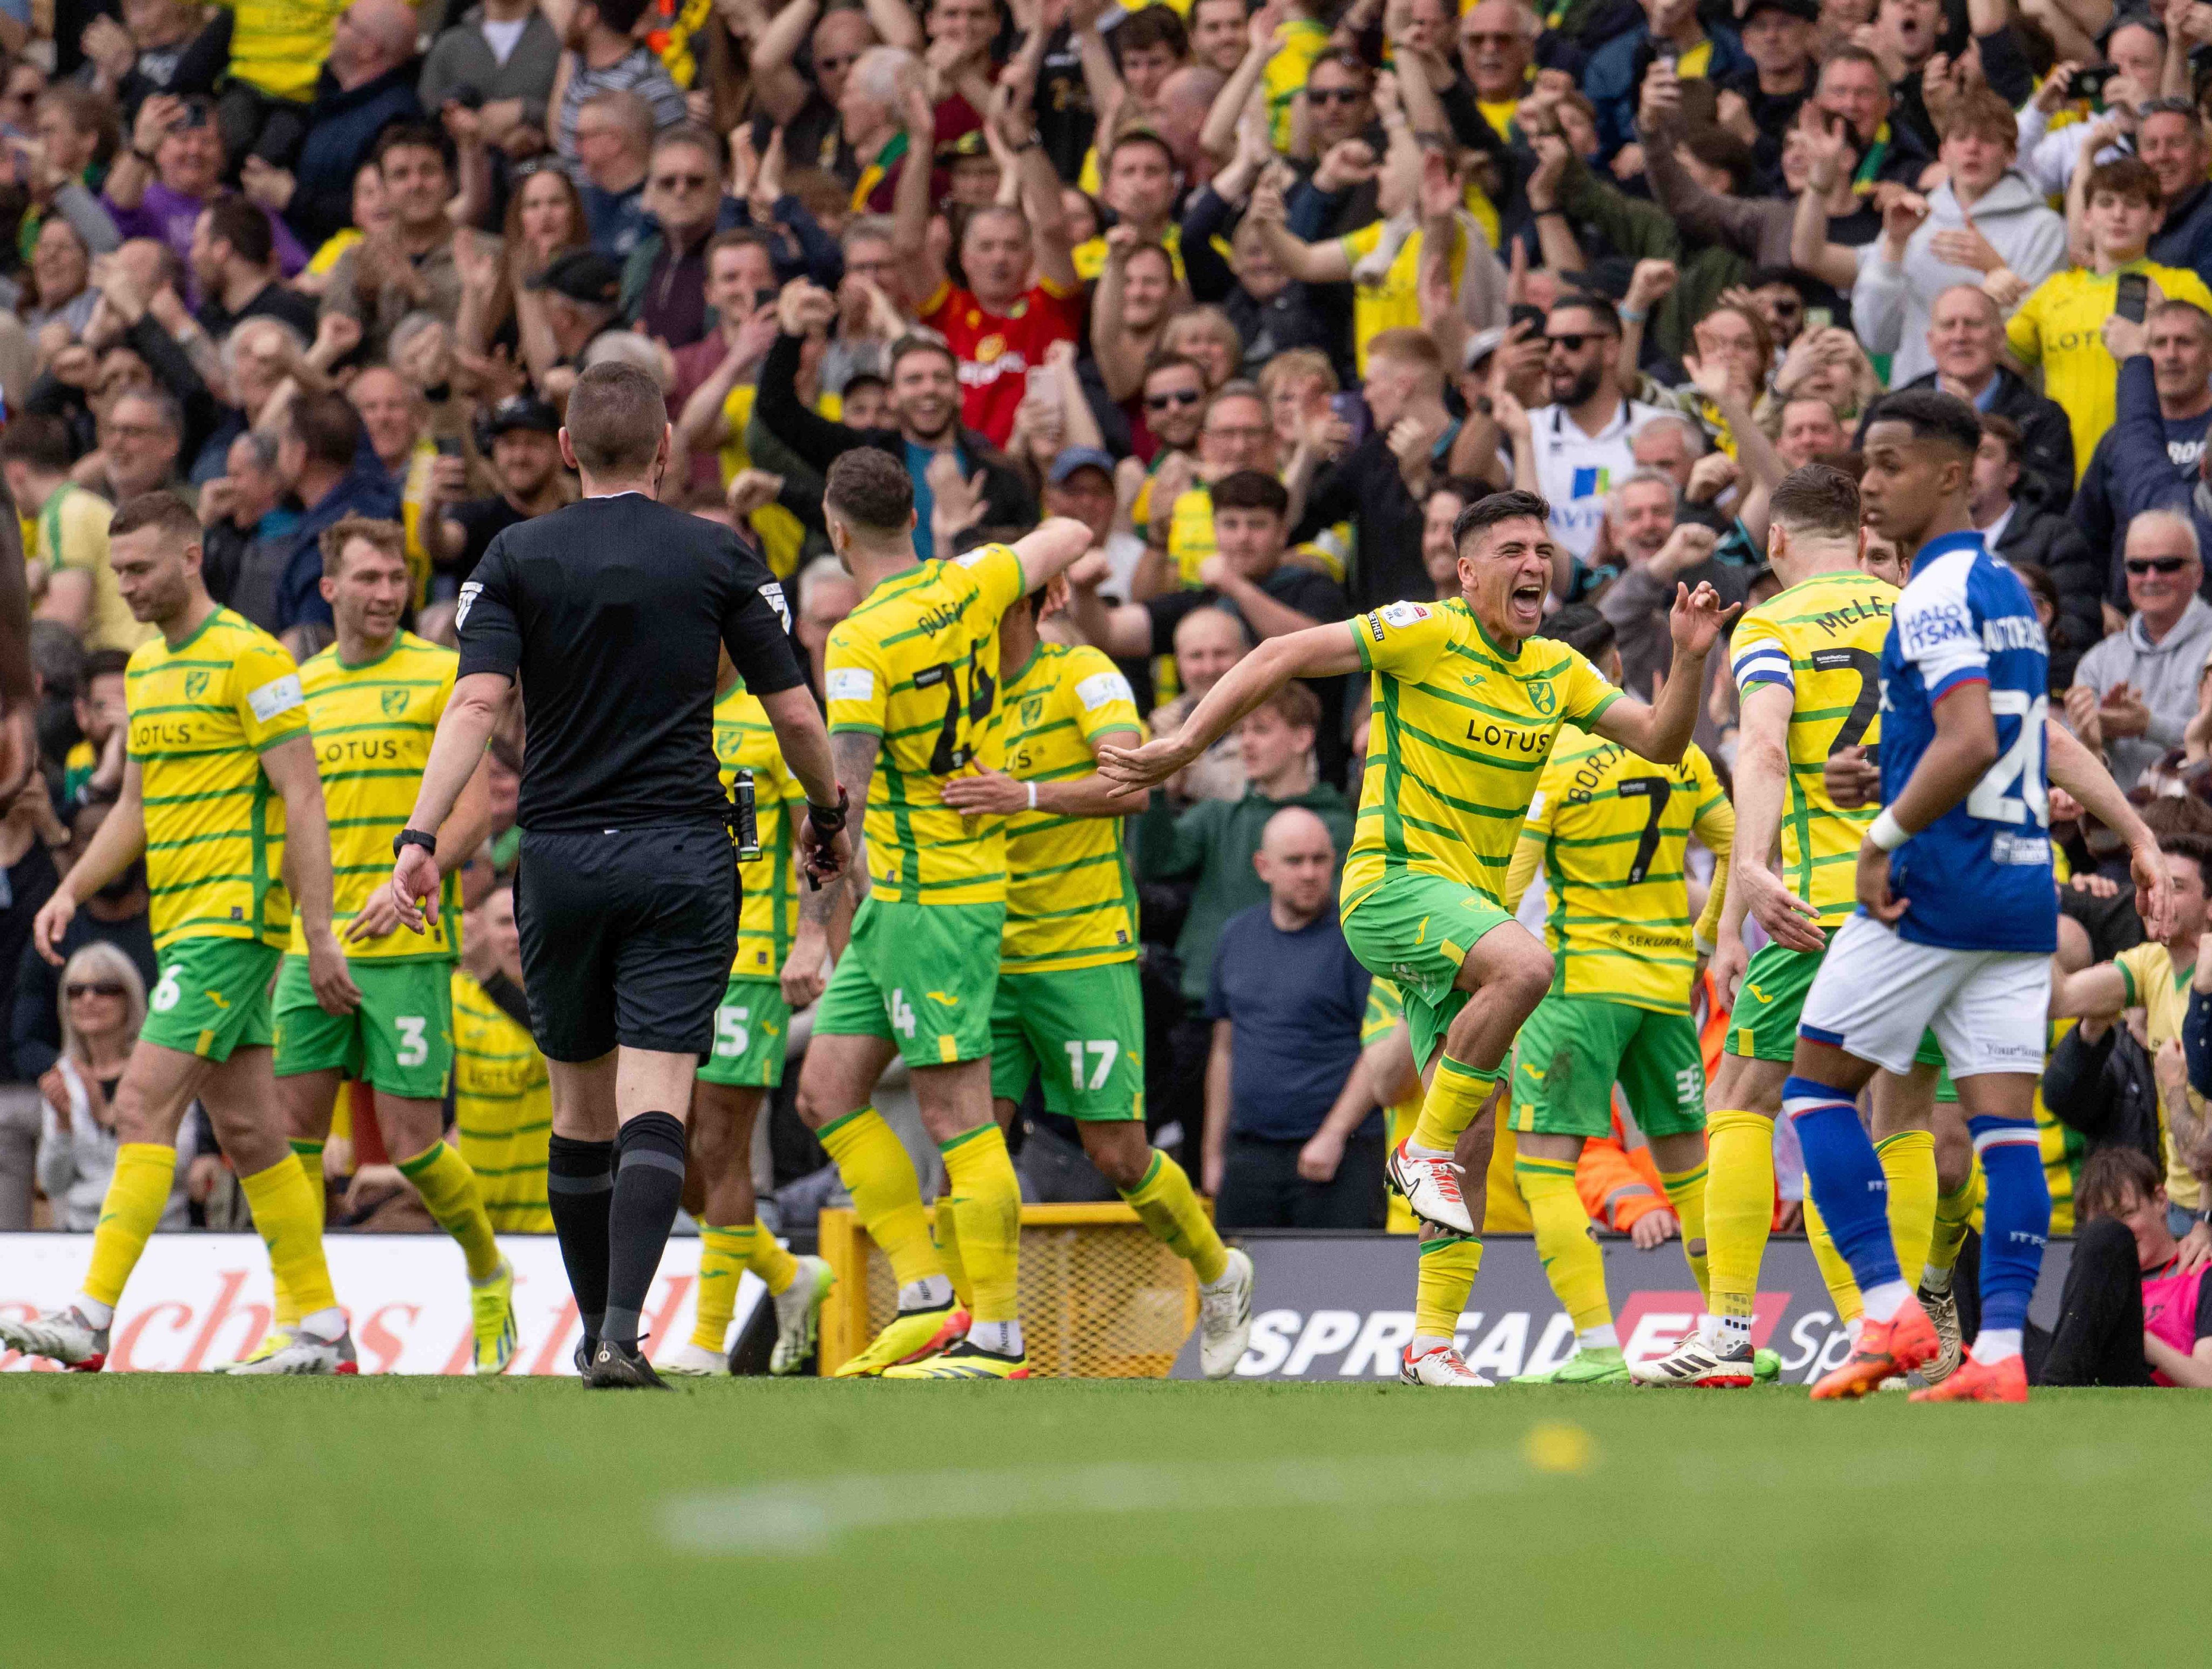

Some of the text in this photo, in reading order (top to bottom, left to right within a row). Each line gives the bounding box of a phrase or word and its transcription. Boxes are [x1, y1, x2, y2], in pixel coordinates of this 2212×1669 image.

[1815, 596, 1896, 637] MCLE
[133, 723, 191, 748] LOTUS
[316, 739, 397, 764] OTUS
[1466, 719, 1550, 753] LOTUS
[1617, 776, 1671, 886] 7
[154, 964, 183, 1011] 6
[395, 1016, 428, 1066] 3
[1064, 1040, 1118, 1090] 17
